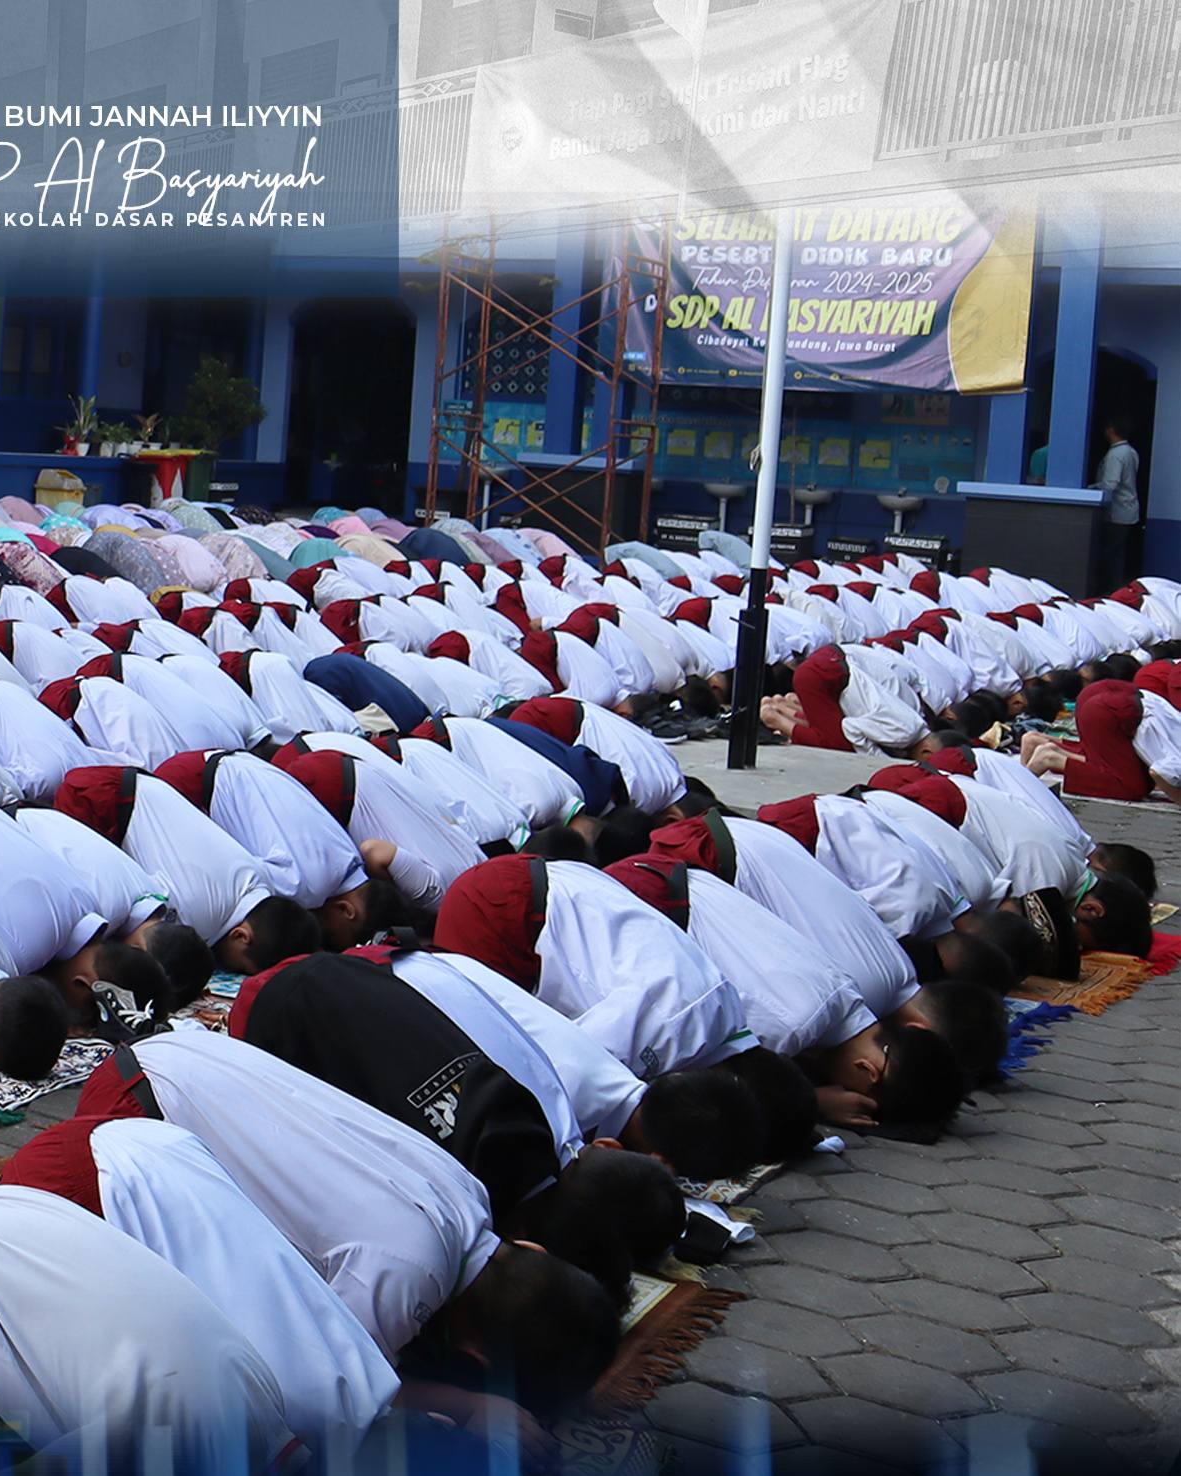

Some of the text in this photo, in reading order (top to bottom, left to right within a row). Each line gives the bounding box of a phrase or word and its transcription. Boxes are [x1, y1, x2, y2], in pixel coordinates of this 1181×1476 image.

[800, 51, 850, 82] Flag
[798, 86, 866, 122] Nanti
[824, 207, 963, 243] DATANG
[681, 245, 773, 265] PESERT
[880, 247, 953, 267] BARU
[822, 271, 935, 294] 2024-2025
[665, 294, 720, 329] SDP
[722, 296, 755, 331] AL
[786, 339, 831, 352] andung,
